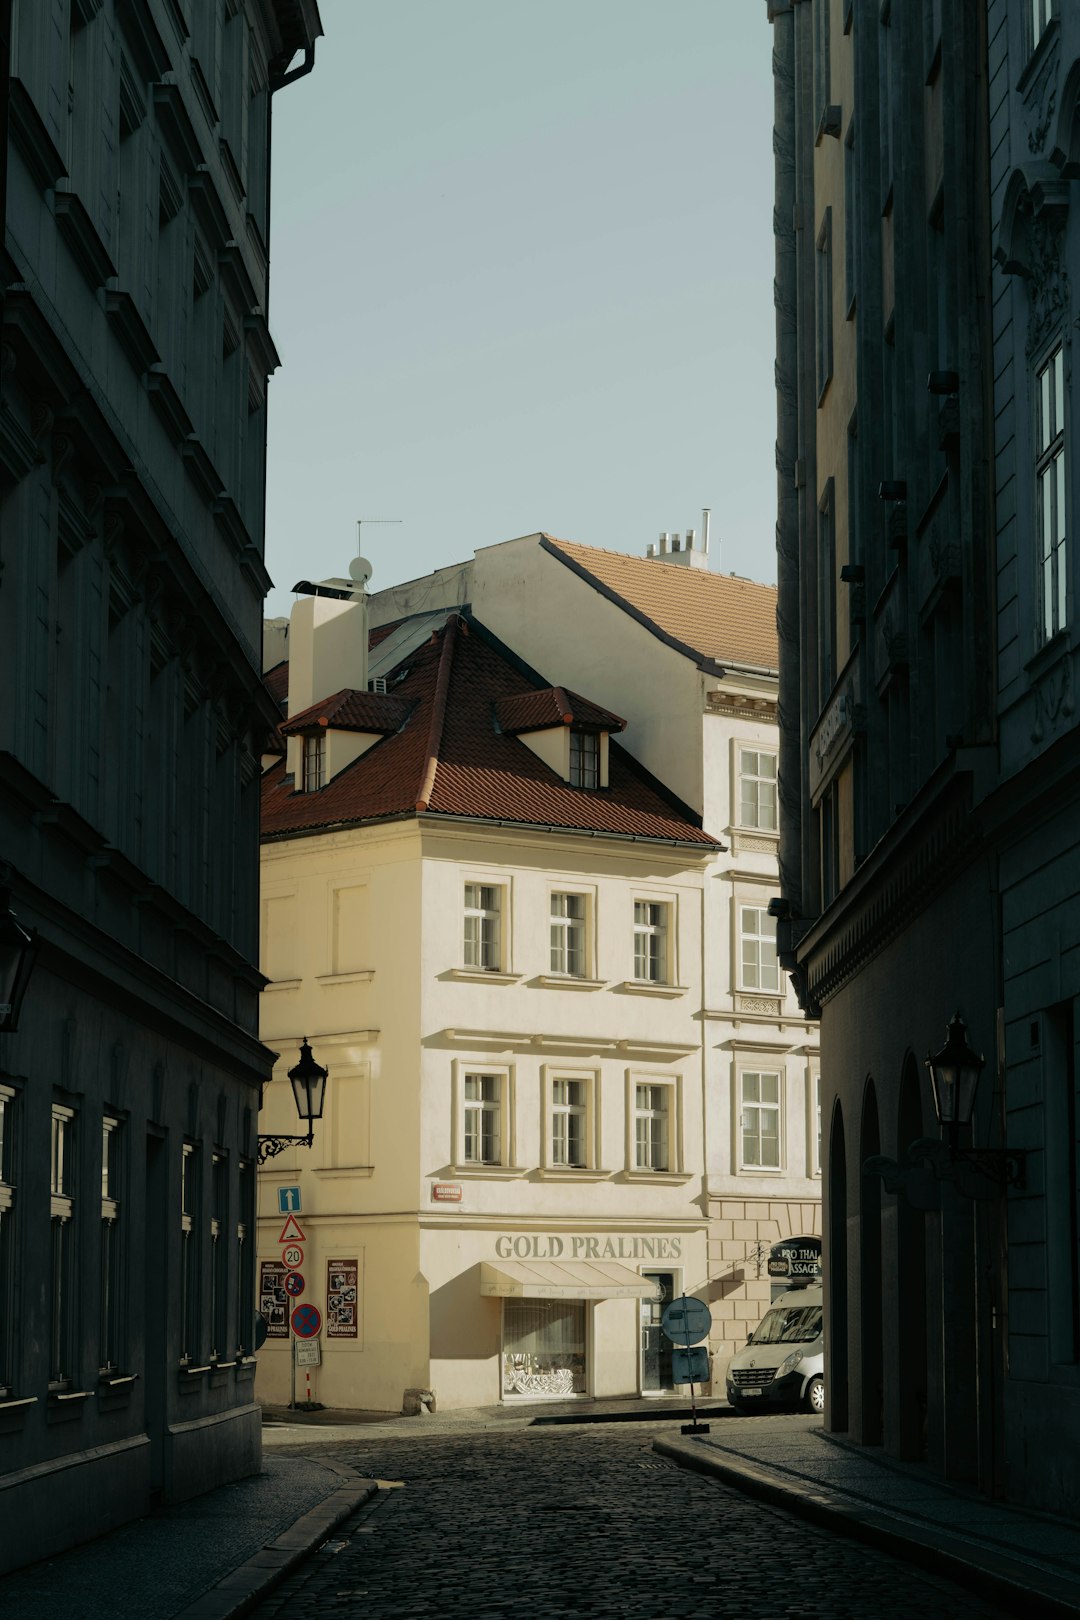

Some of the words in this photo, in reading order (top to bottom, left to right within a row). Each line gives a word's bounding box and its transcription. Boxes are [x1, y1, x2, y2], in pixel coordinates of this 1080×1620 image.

[495, 1235, 564, 1258] GOLD
[570, 1236, 682, 1259] PRALINES
[287, 1251, 300, 1263] 20
[782, 1249, 797, 1259] PRO
[799, 1250, 817, 1259] THAI
[790, 1264, 818, 1273] ASSAGE
